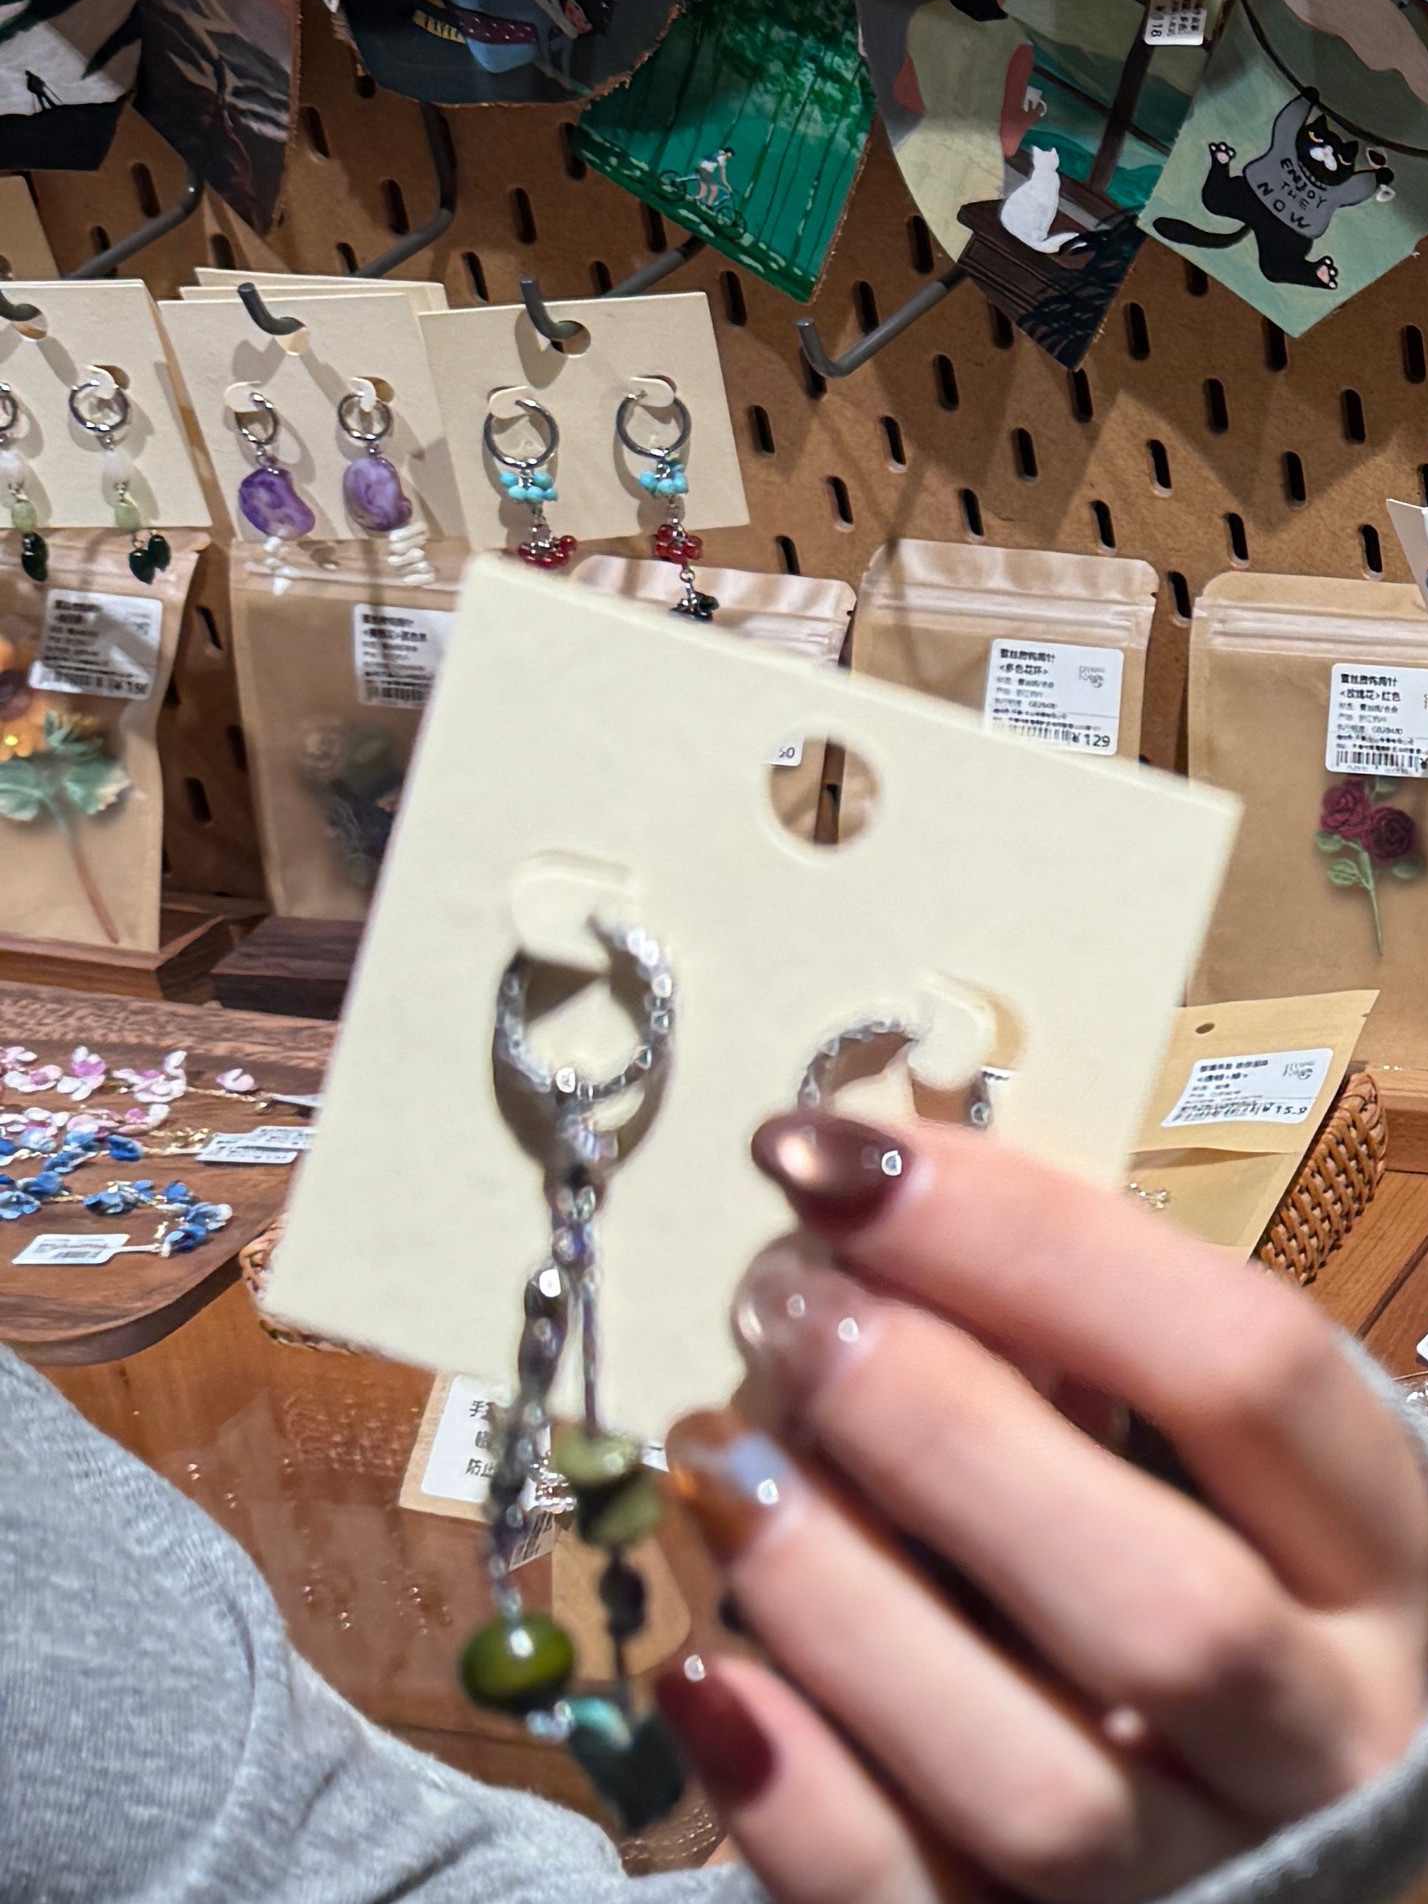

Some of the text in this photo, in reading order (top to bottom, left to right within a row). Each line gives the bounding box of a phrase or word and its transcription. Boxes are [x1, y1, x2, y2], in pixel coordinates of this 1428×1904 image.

[1257, 182, 1310, 229] NOW
[1280, 158, 1328, 209] ENJOY
[1072, 732, 1111, 748] ¥129
